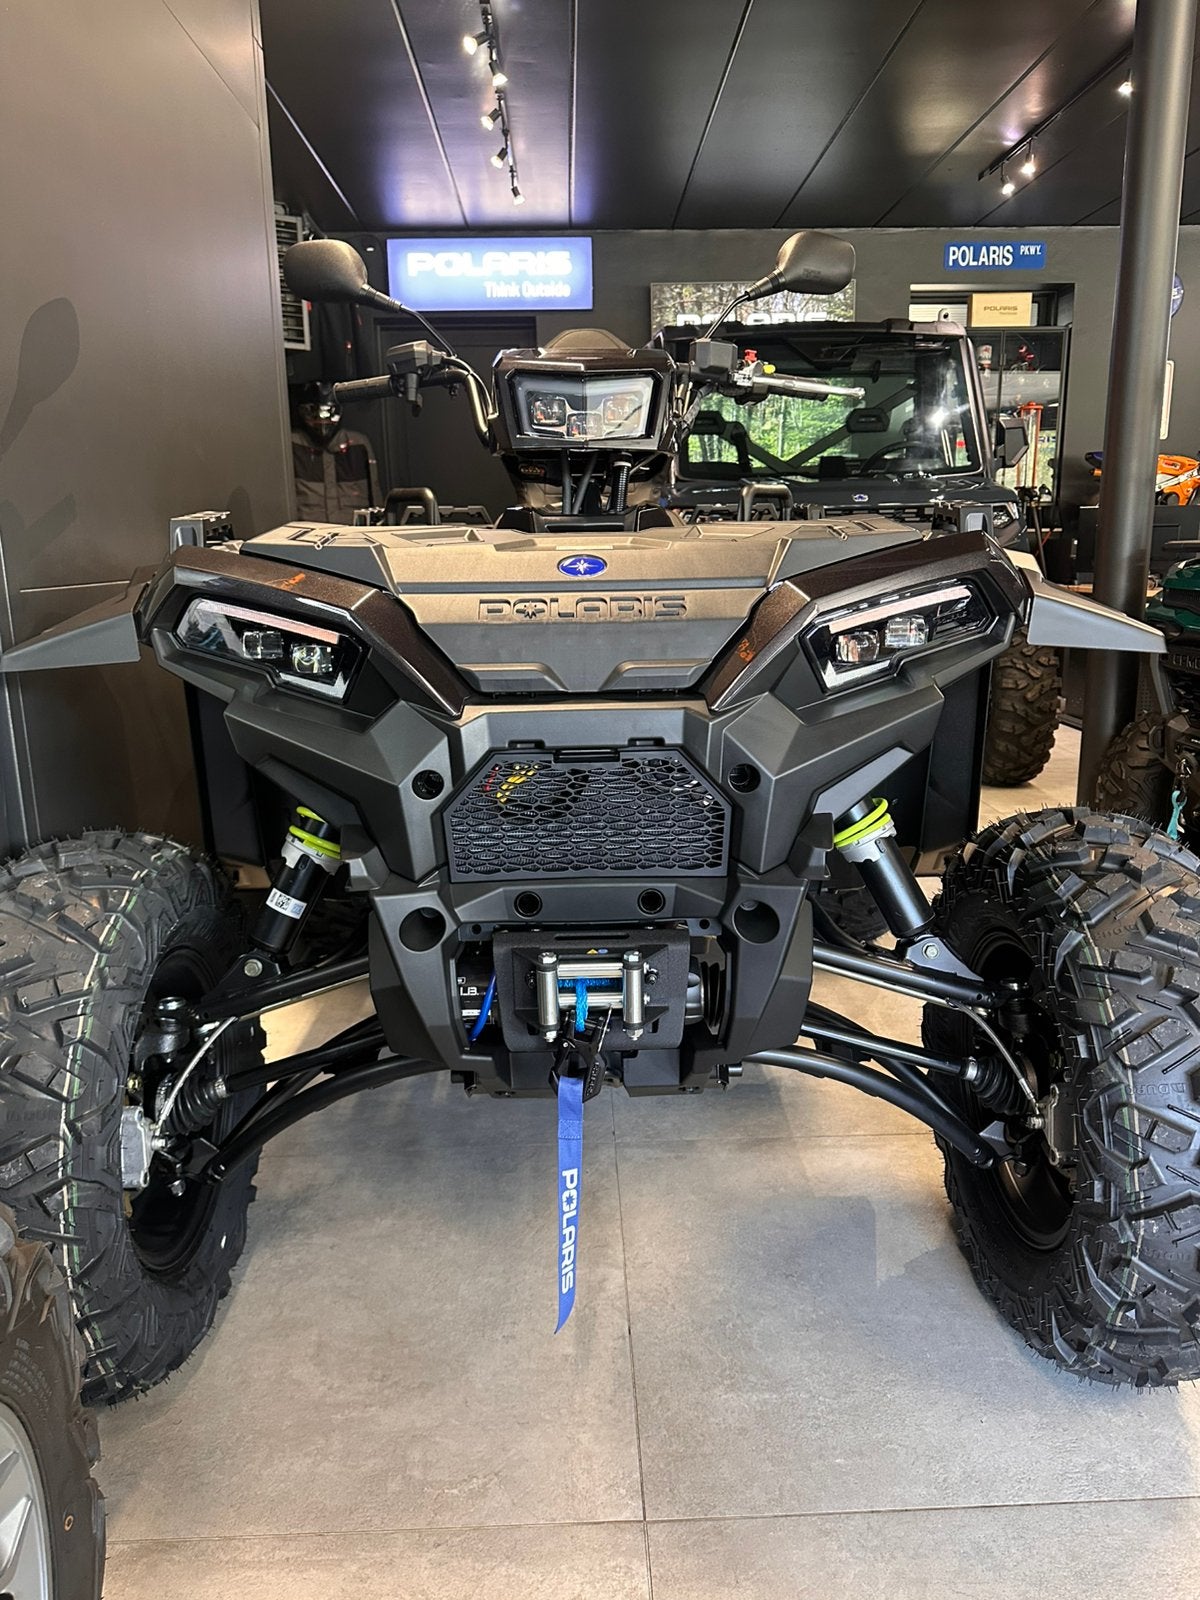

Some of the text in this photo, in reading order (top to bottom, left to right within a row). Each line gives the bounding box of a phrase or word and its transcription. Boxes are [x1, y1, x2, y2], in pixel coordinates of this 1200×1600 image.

[407, 251, 572, 277] POLARIS
[948, 245, 1013, 267] POLARIS
[484, 280, 571, 298] Think Outside
[479, 596, 687, 622] POLARIS
[561, 1167, 578, 1295] POLARIS
